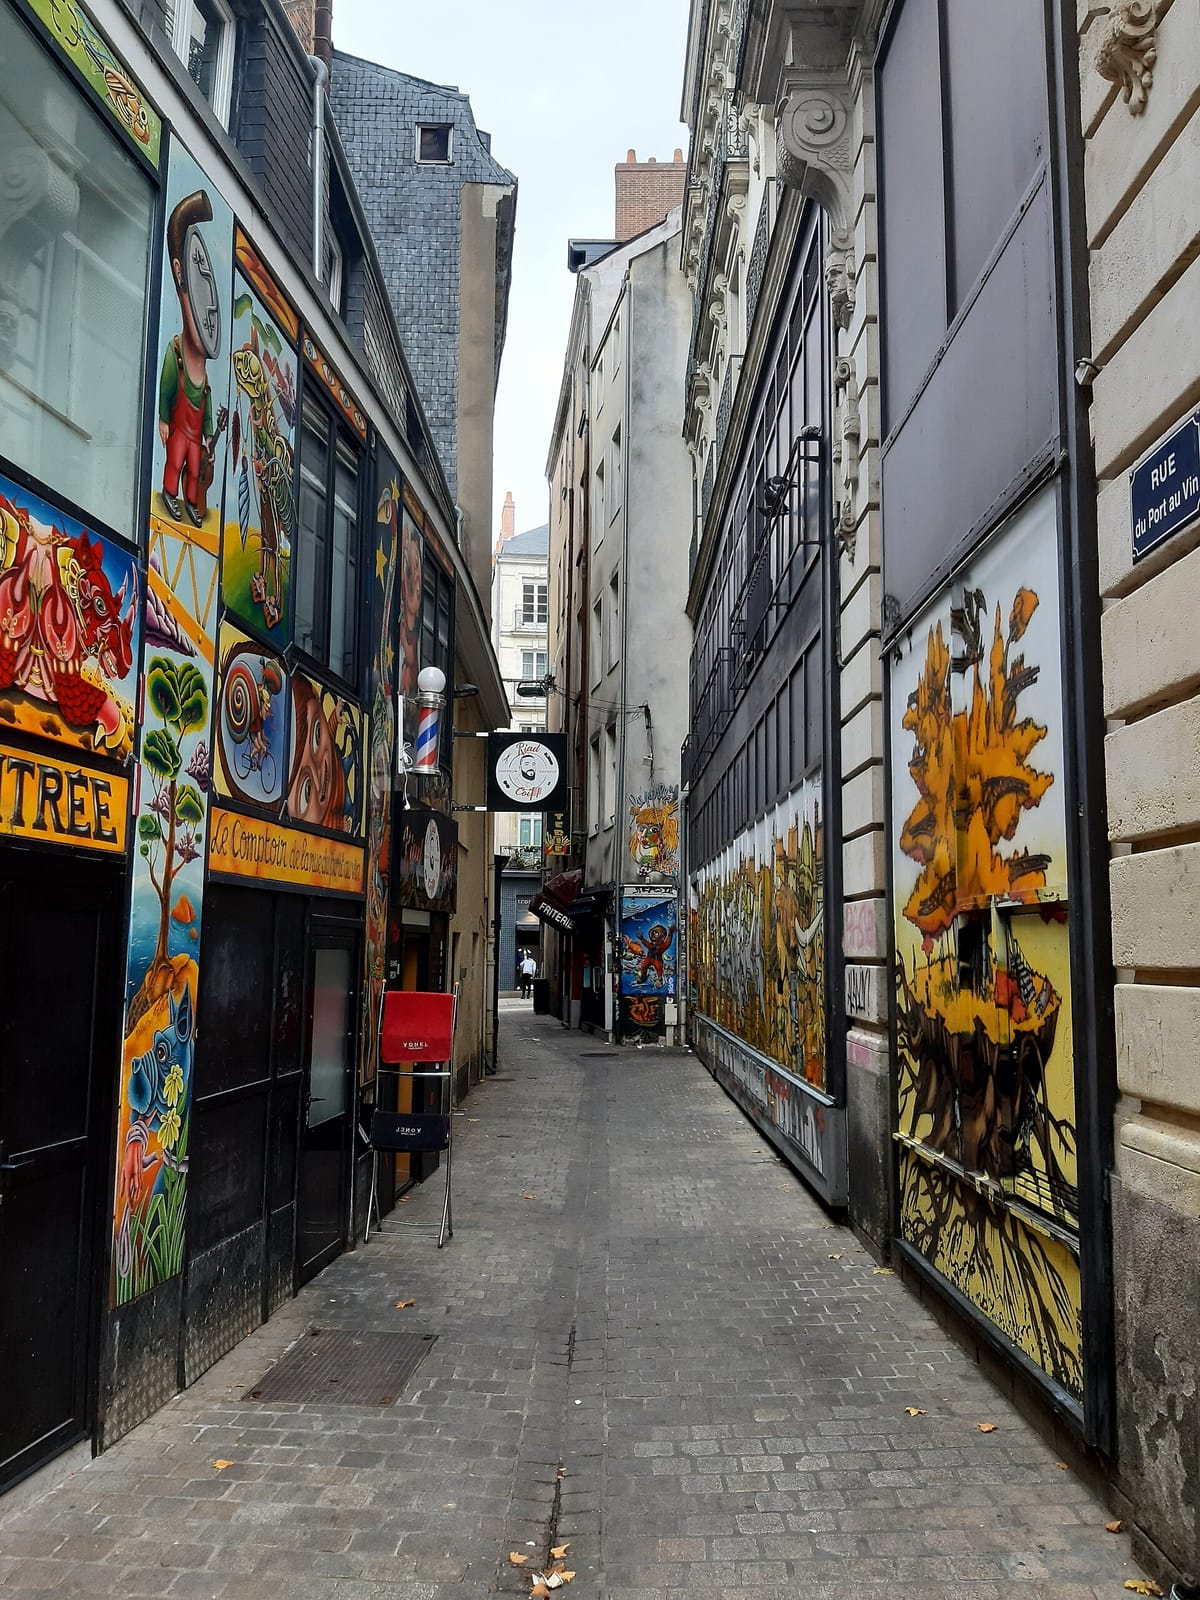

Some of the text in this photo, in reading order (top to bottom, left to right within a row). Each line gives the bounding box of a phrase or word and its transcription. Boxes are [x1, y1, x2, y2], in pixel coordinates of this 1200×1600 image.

[1151, 452, 1177, 491] RUE
[1135, 474, 1200, 539] du Port au Vin
[516, 743, 541, 756] Riad
[0, 754, 118, 844] TRÉE
[210, 812, 229, 856] Le
[232, 819, 288, 875] Comptoir
[538, 901, 576, 930] FRITERIE
